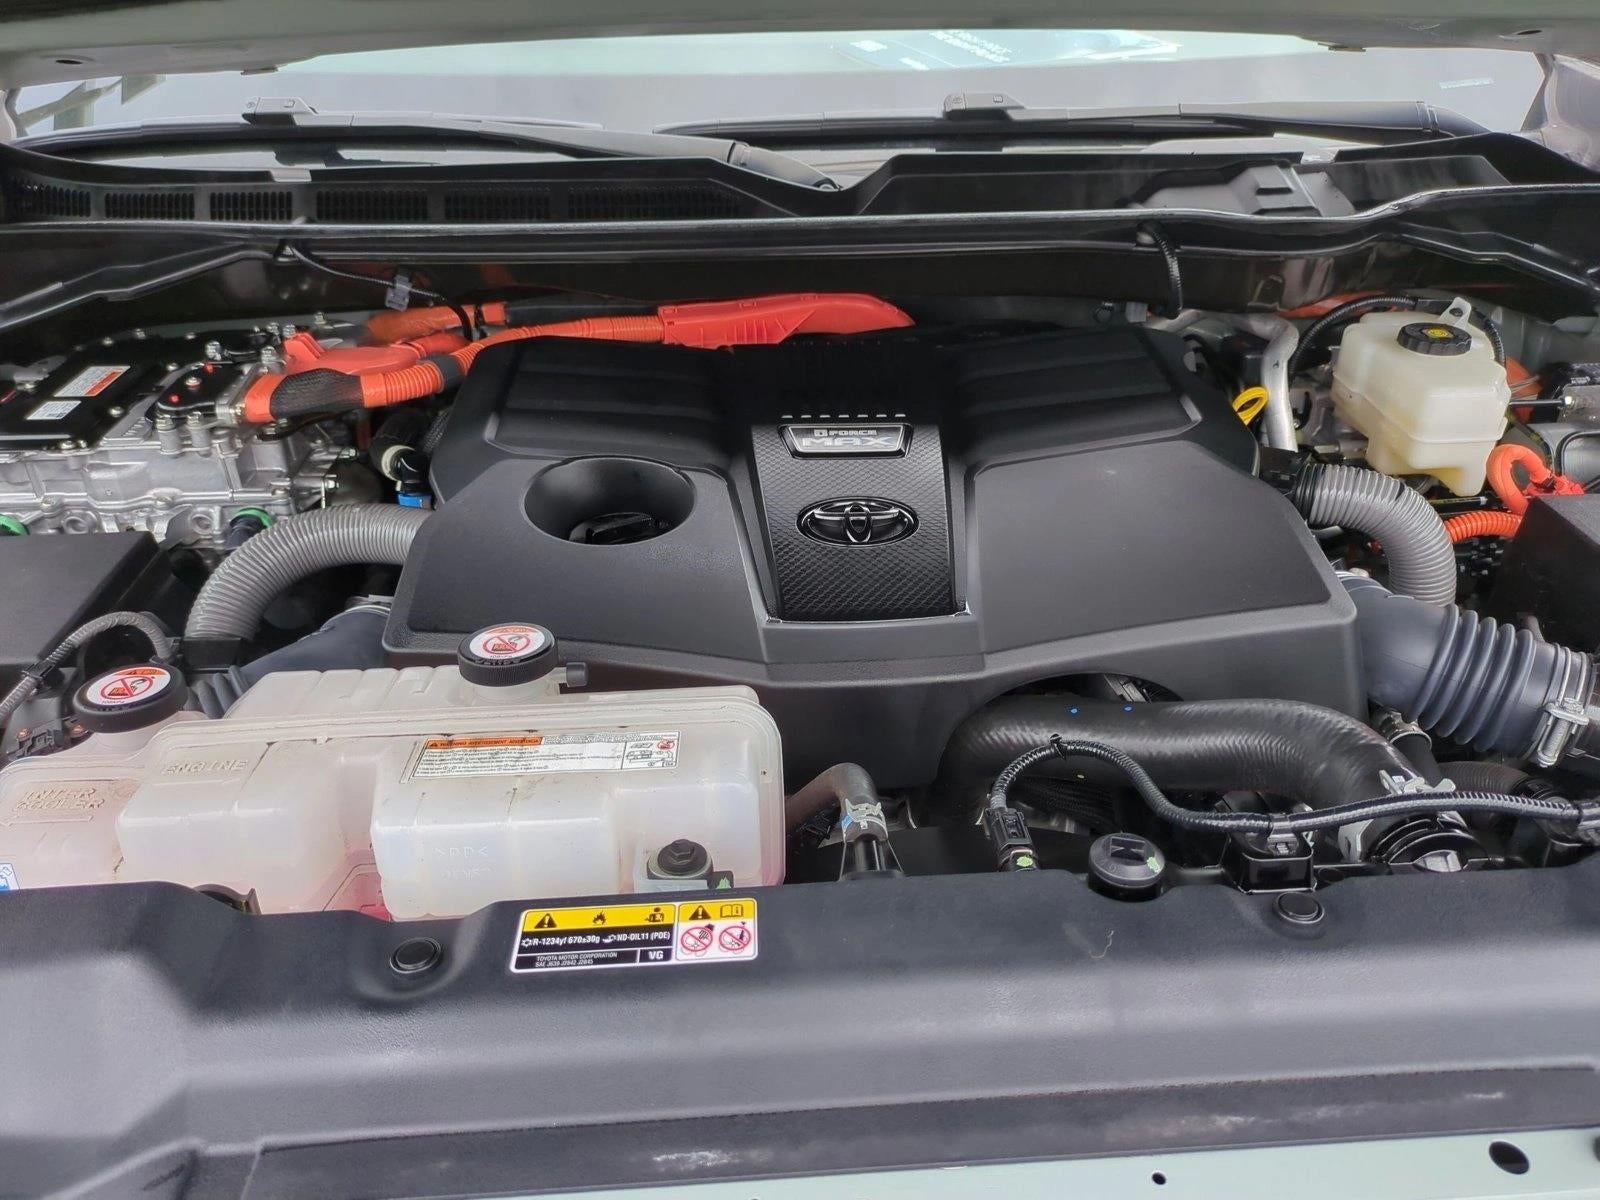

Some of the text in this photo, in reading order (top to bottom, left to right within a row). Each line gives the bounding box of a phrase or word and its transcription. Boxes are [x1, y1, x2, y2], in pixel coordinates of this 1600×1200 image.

[802, 437, 894, 446] MAX
[165, 759, 247, 775] ENGINE
[26, 788, 96, 800] INTER
[16, 799, 105, 809] COOLER
[617, 931, 671, 941] ND-OIL11 (POE)
[533, 937, 566, 946] R-1234yf
[580, 952, 617, 960] CORPORATION
[648, 950, 664, 960] VG
